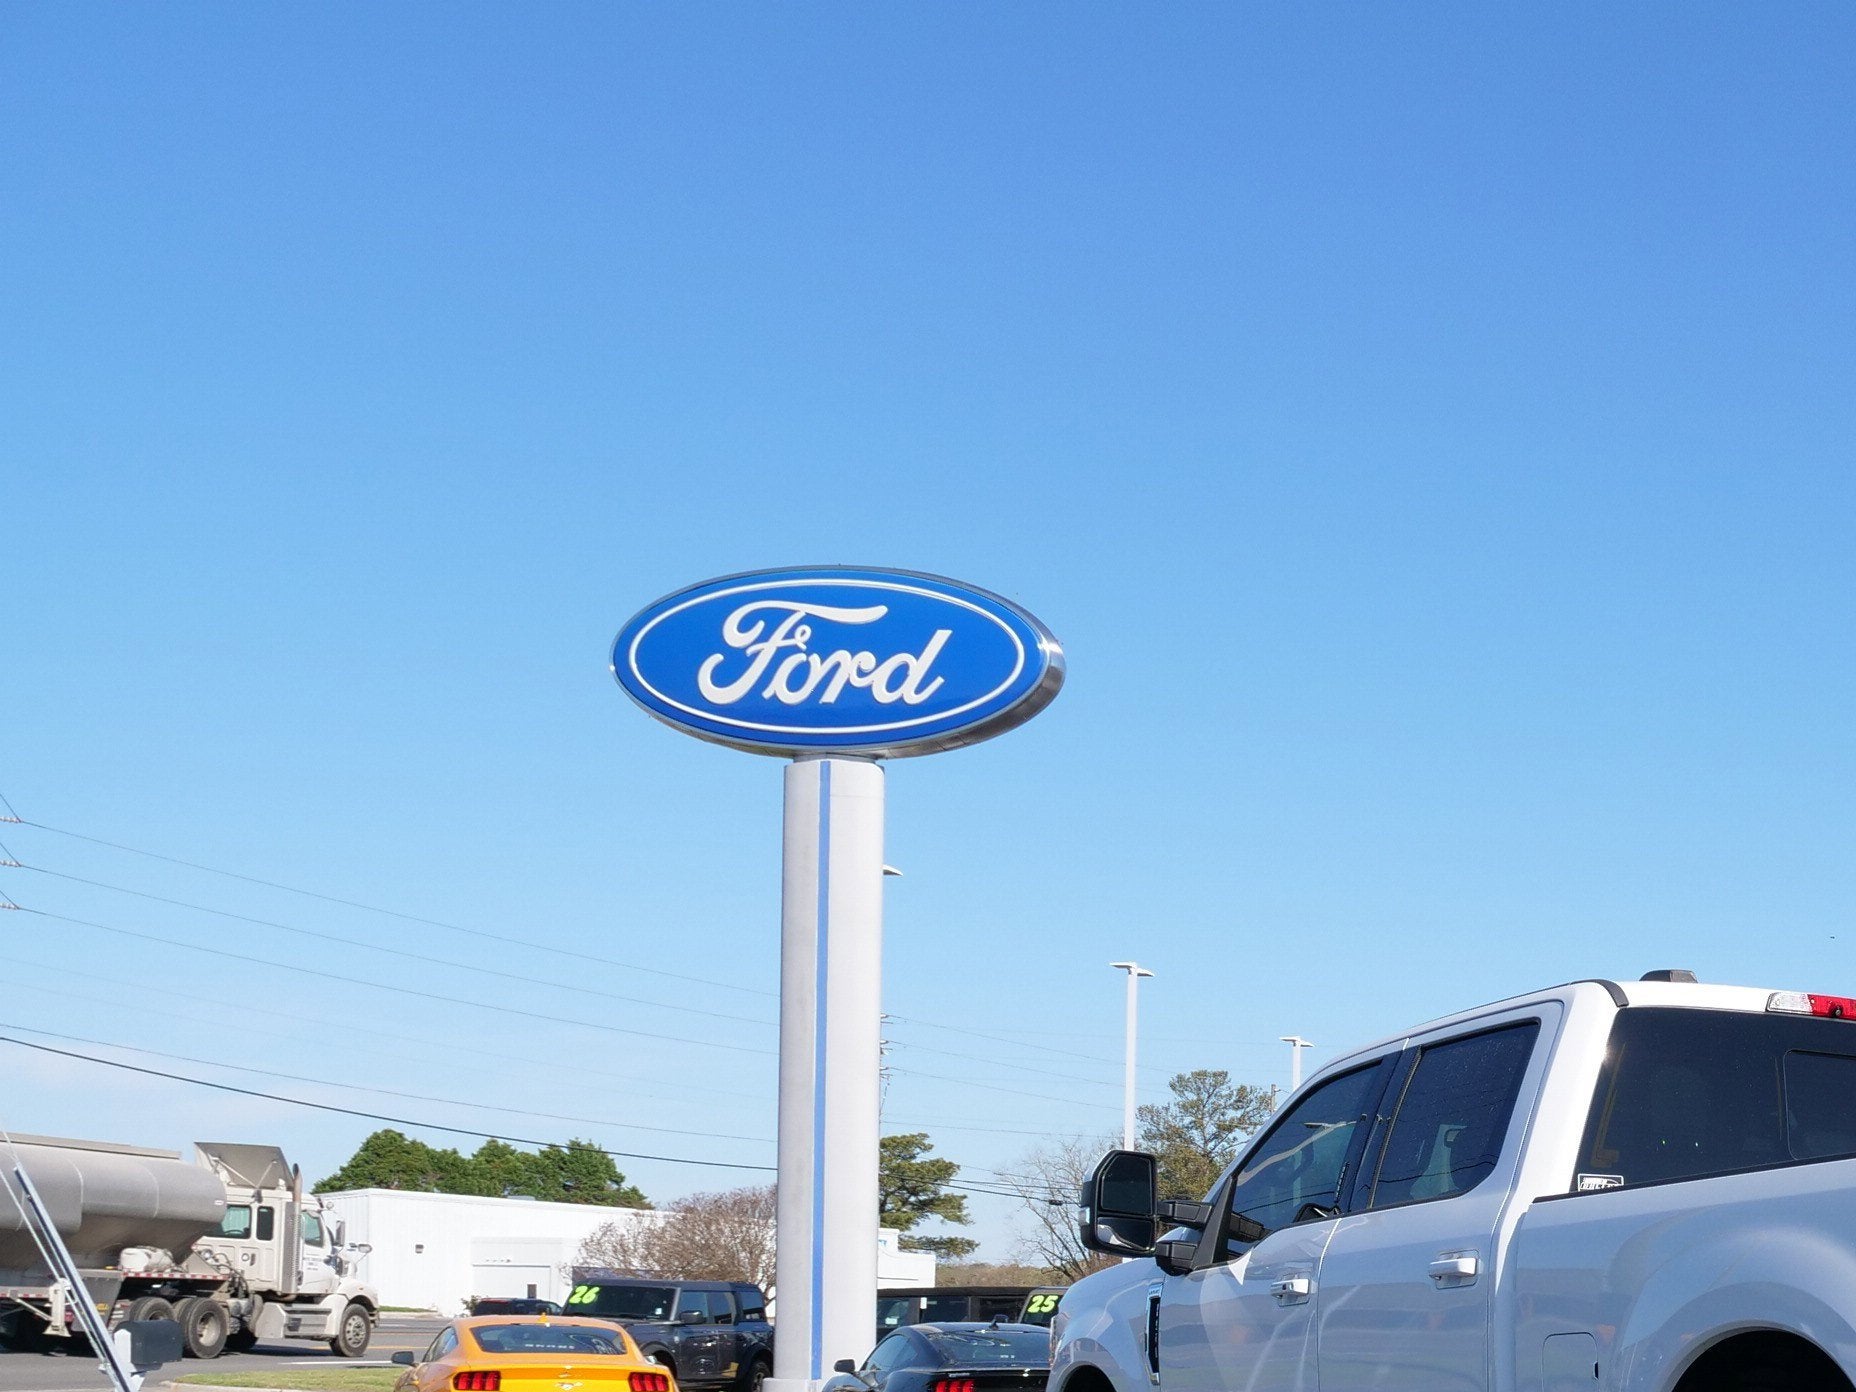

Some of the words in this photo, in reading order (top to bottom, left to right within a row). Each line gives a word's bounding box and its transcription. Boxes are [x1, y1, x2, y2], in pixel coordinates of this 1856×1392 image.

[697, 599, 953, 705] Ford
[568, 1285, 600, 1305] 26
[1027, 1294, 1059, 1313] 25
